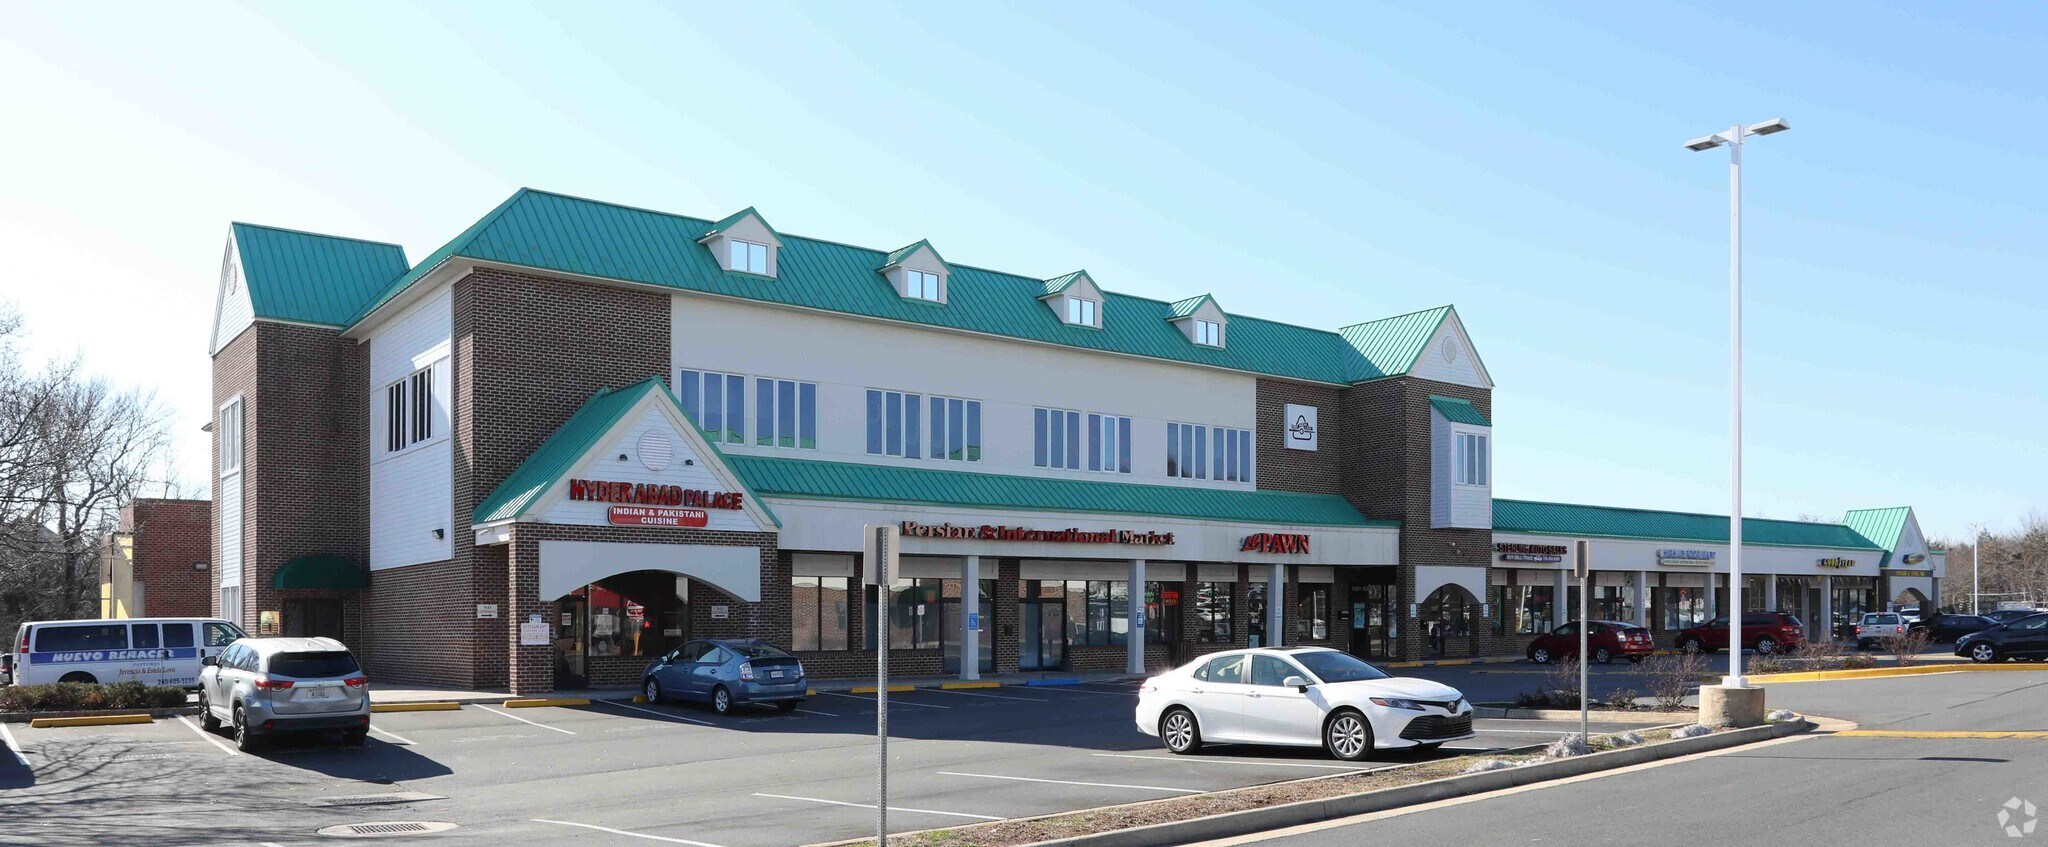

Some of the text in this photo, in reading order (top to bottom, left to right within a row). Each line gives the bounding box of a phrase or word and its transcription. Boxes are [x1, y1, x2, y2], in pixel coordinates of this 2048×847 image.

[570, 479, 743, 510] HYDERABAD PALACE
[613, 507, 646, 516] INDIAN
[657, 510, 705, 518] PAKISTANI
[641, 516, 679, 526] CUISINE
[901, 520, 975, 540] Persian
[998, 525, 1117, 544] International
[1120, 530, 1175, 545] Market
[52, 652, 104, 662] NUEVO
